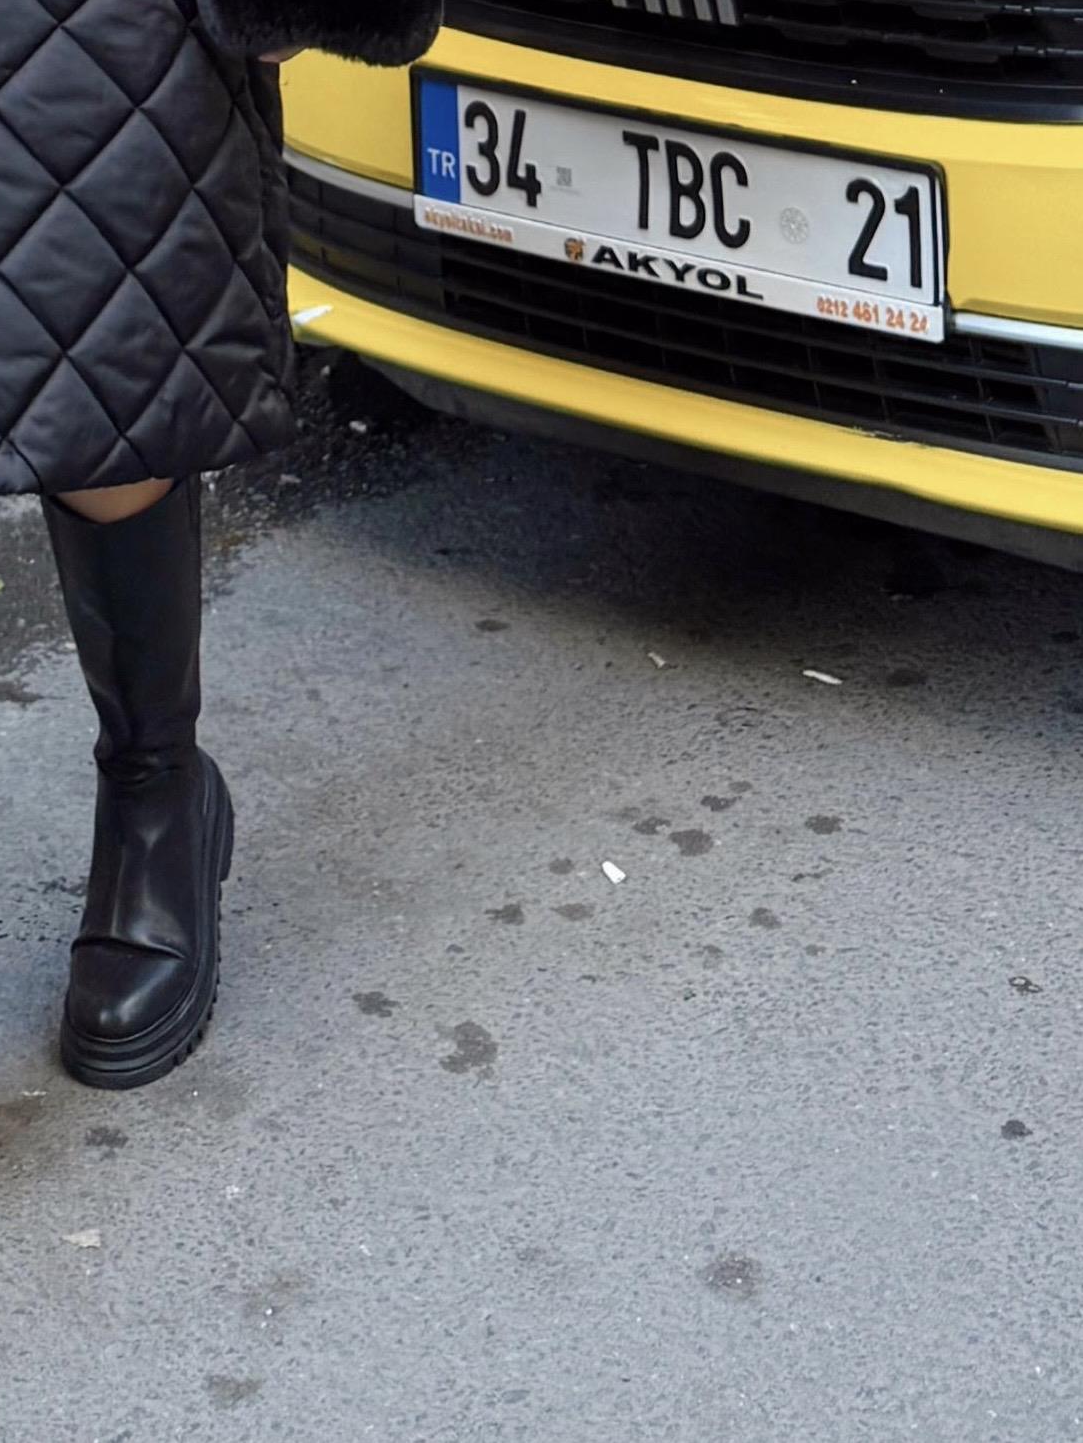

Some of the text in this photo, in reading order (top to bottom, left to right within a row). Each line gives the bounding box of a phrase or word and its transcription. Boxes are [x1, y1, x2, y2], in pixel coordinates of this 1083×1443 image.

[427, 148, 455, 179] TR
[464, 100, 922, 289] 34 TBC 21
[591, 245, 764, 301] AKYOL
[817, 296, 848, 318] 0212
